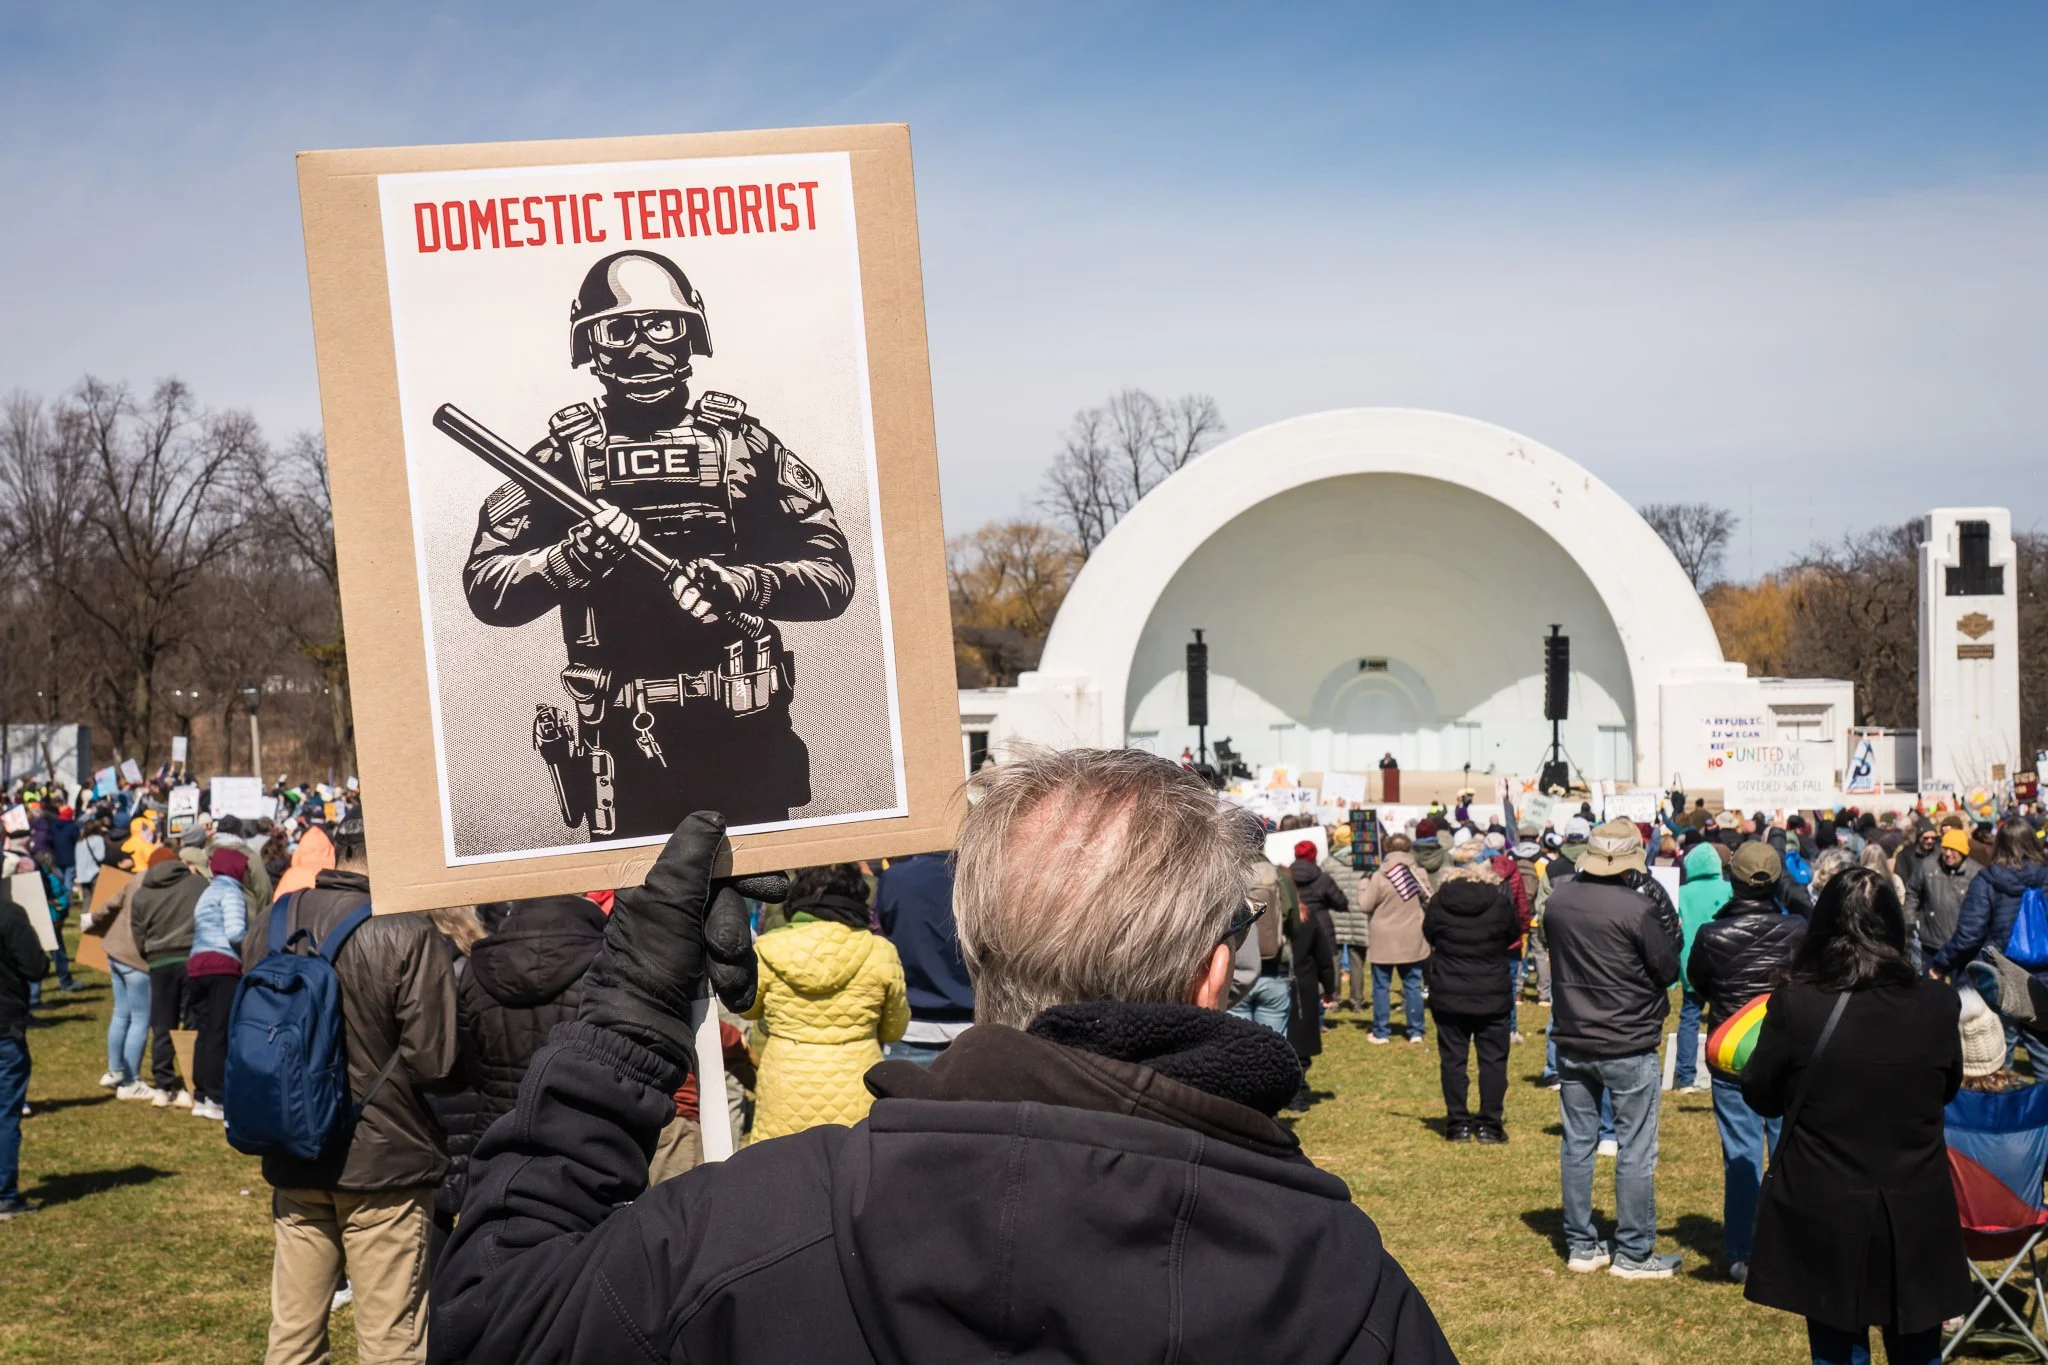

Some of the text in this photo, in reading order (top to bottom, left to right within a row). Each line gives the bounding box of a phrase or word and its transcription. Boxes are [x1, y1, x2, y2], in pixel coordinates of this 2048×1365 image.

[414, 181, 818, 253] DOMESTIC TERRORIST
[617, 448, 690, 476] ICE
[1736, 746, 1784, 762] UNITED
[1708, 757, 1723, 769] NO
[1763, 763, 1806, 777] STAND
[1737, 780, 1781, 792] DIVIDED
[1784, 780, 1801, 792] WE
